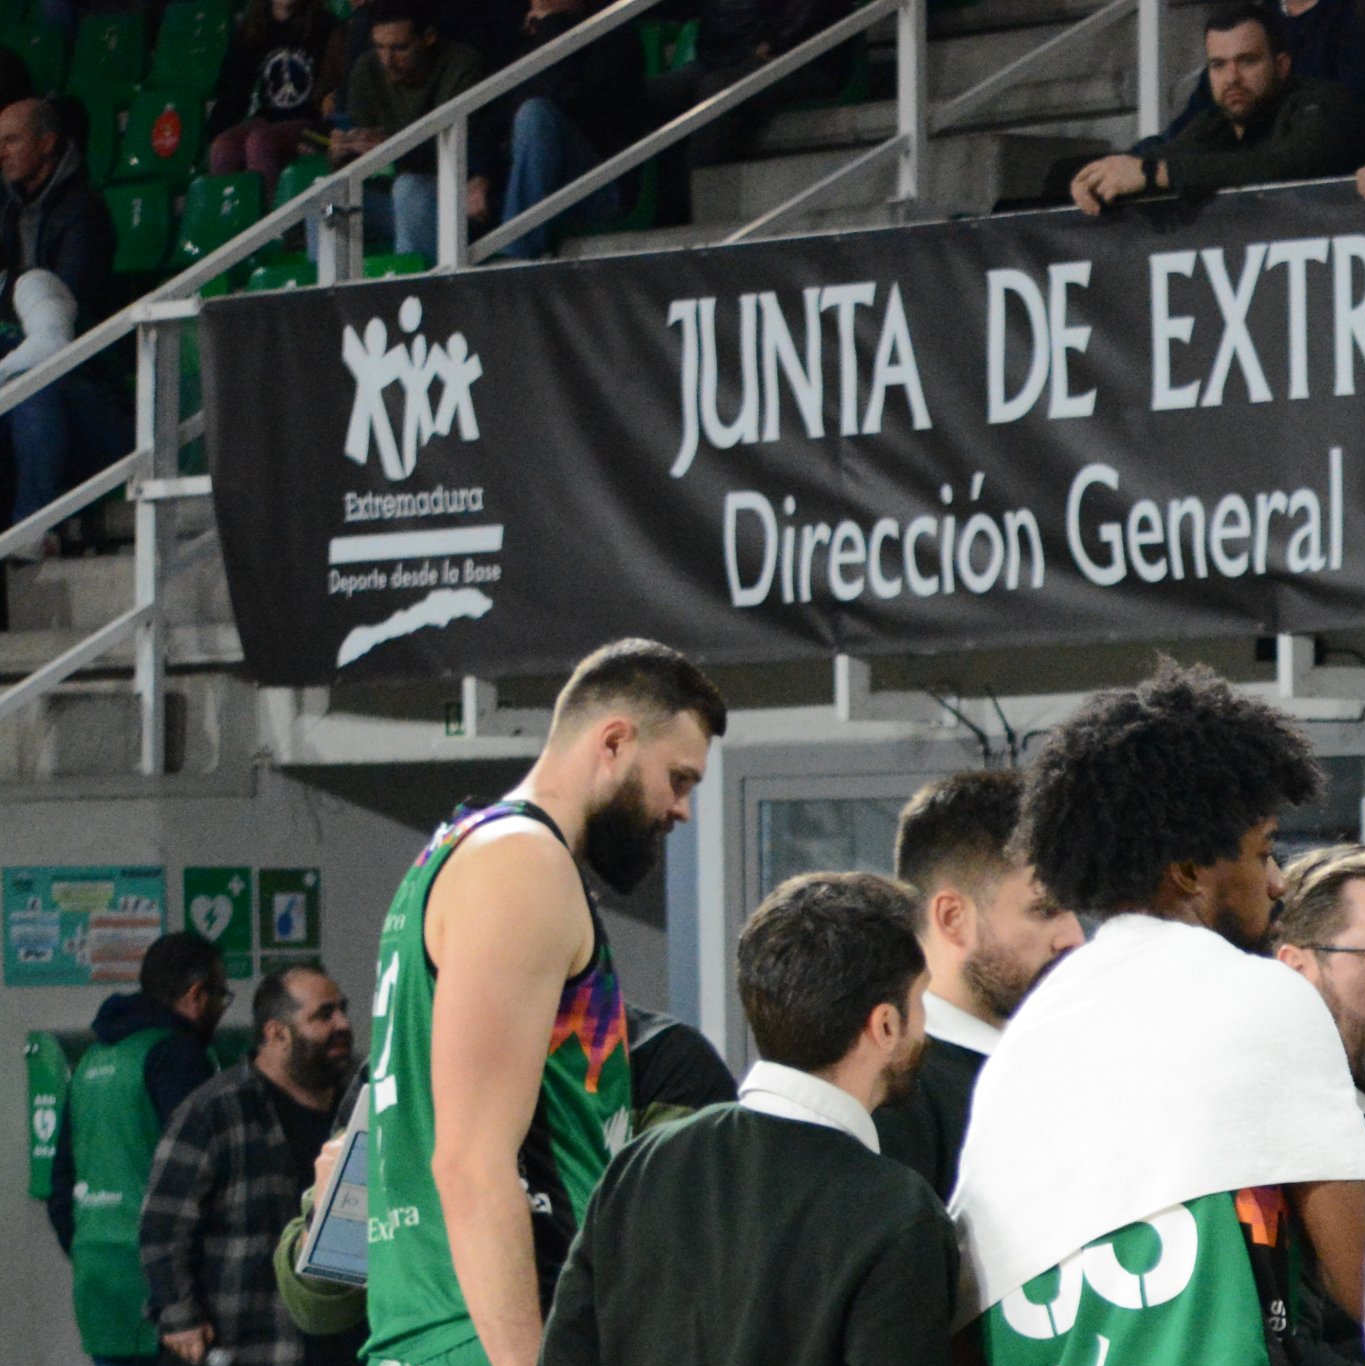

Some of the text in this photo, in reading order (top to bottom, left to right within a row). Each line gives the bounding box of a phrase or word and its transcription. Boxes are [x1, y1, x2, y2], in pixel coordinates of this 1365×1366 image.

[667, 282, 932, 479] JUNTA
[987, 261, 1097, 424] DE
[344, 484, 484, 523] Extremadura
[723, 472, 1045, 607] Dirección
[1066, 447, 1342, 587] General
[328, 558, 502, 599] Deporte desde la Base
